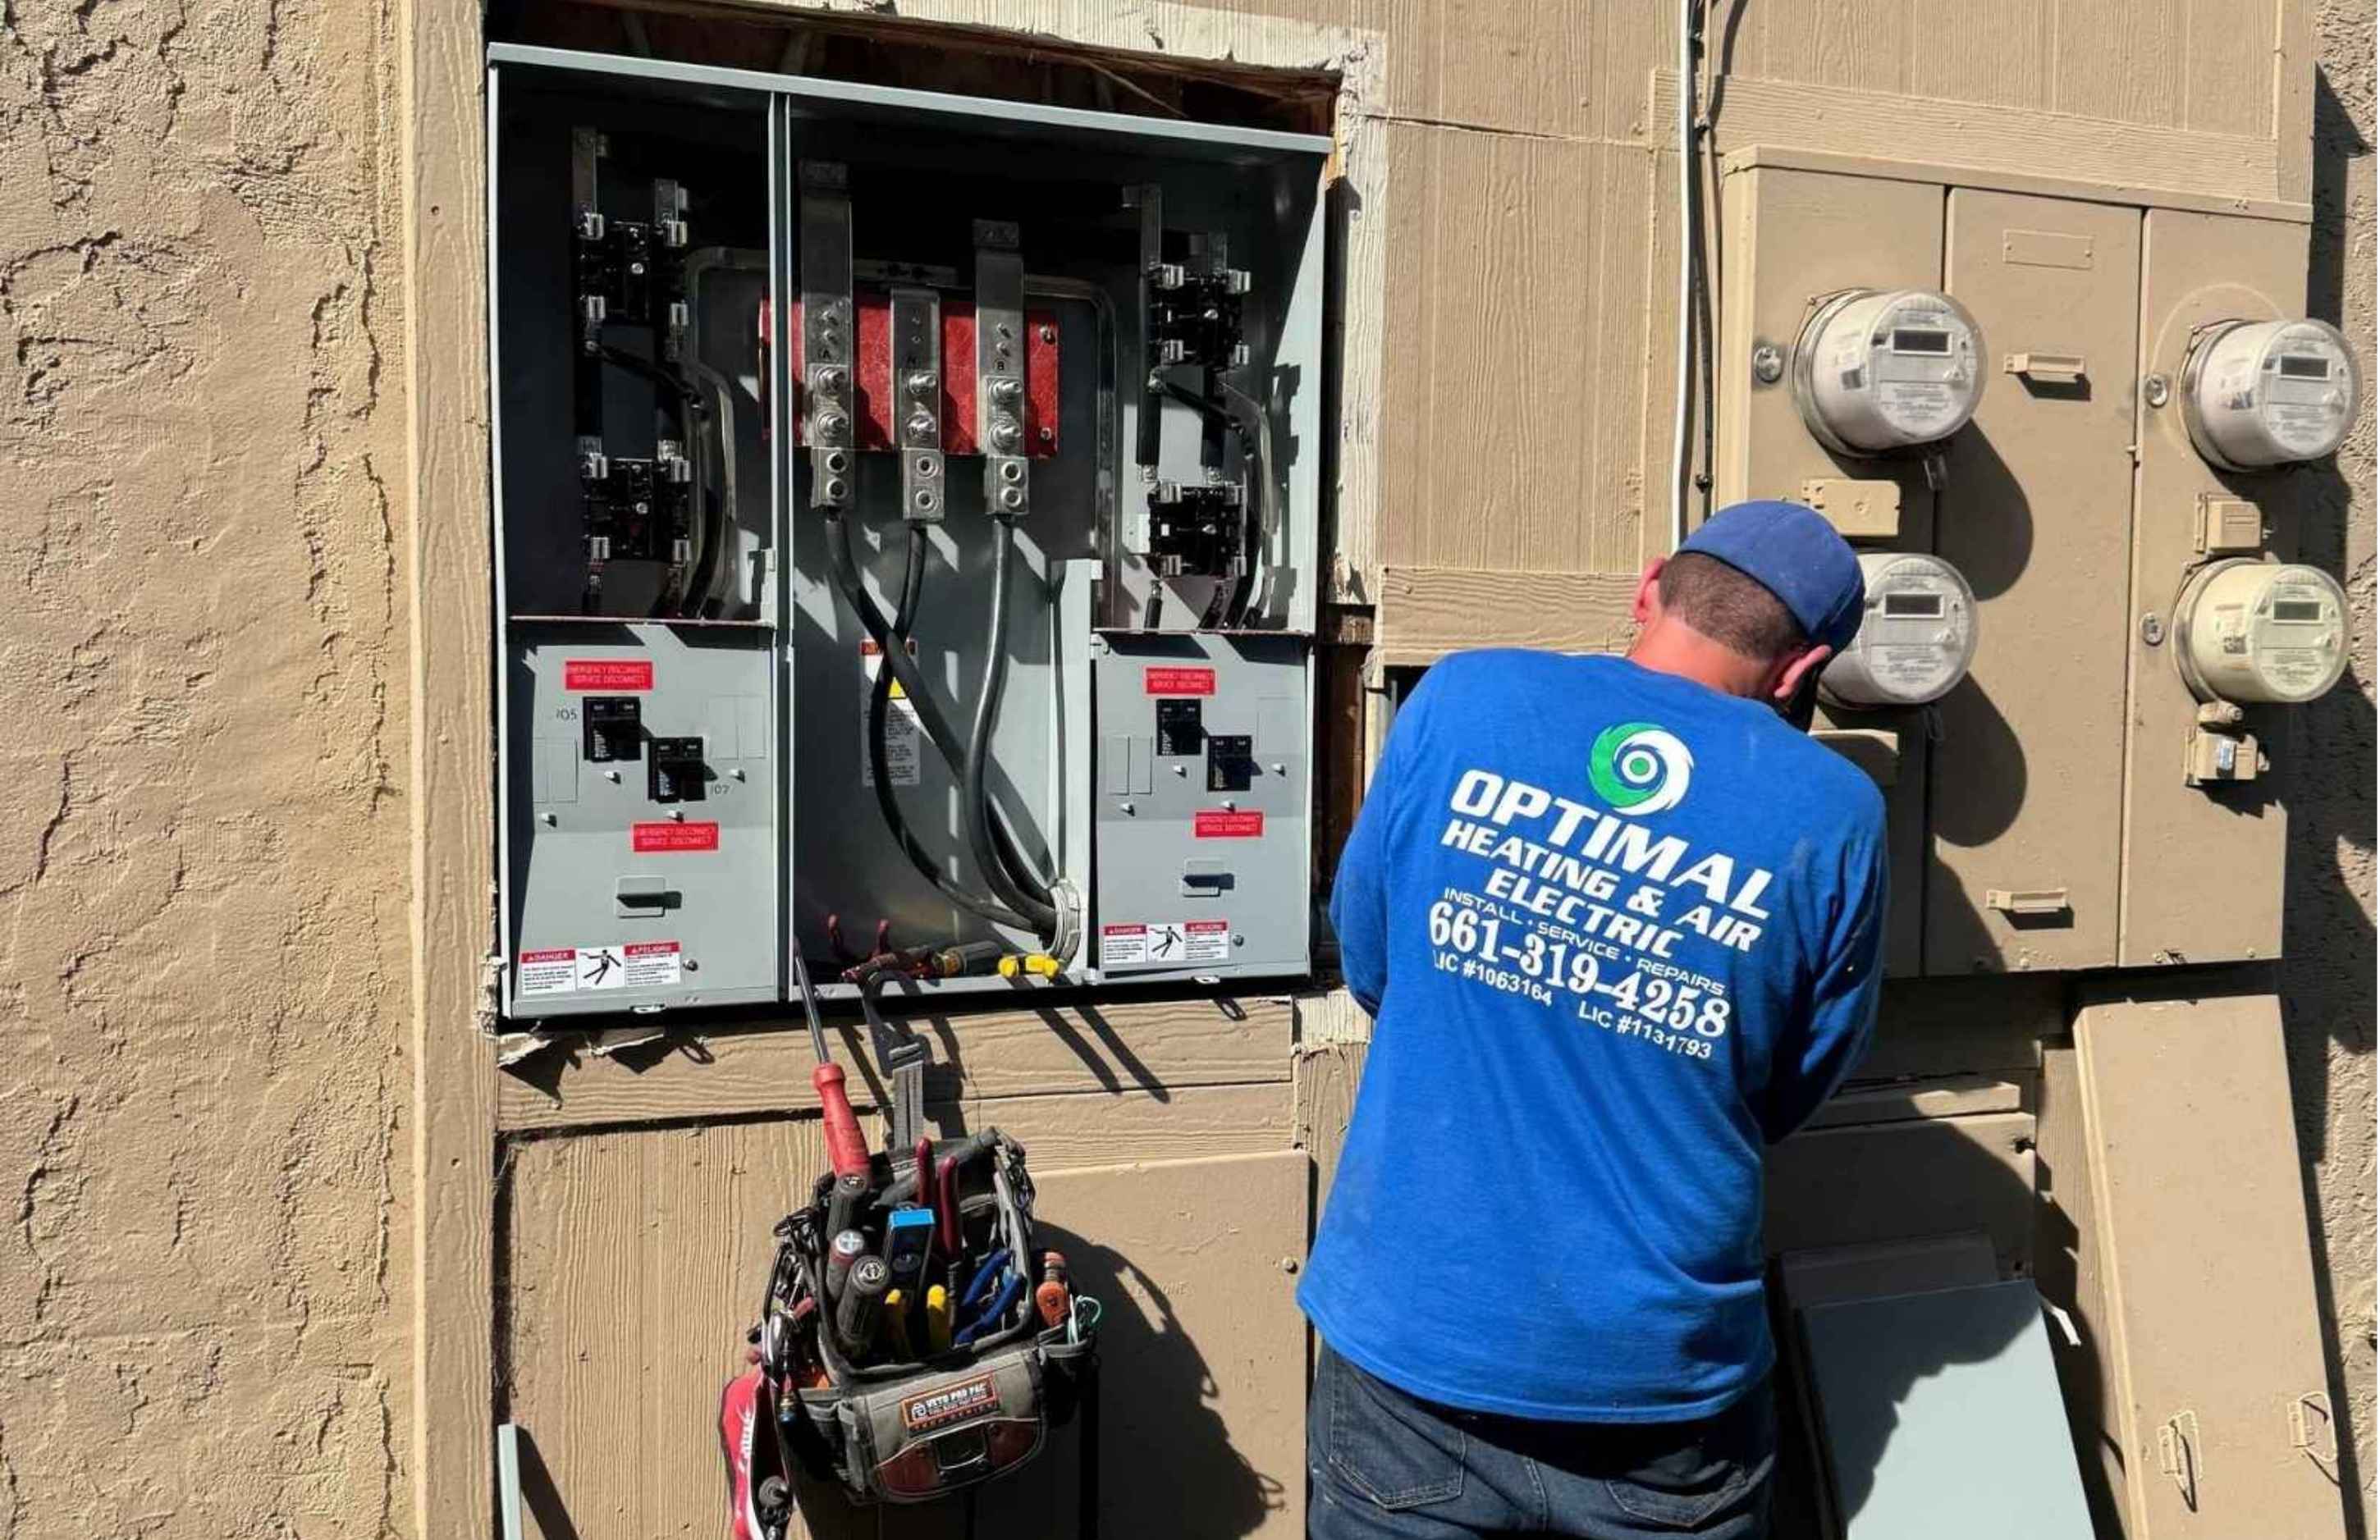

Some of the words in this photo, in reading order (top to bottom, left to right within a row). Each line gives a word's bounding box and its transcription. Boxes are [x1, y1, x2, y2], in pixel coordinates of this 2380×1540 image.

[1441, 820, 1620, 901] HEATING
[1626, 885, 1666, 916] &
[1675, 905, 1763, 952] AIR
[1449, 769, 1774, 919] OPTIMAL
[1444, 887, 1523, 925] INSTALL
[1536, 921, 1621, 961] SERVICE
[1636, 957, 1727, 996] REPAIRS
[1484, 868, 1686, 958] ELECTRIC
[1430, 901, 1731, 1038] 661-319-4258
[1432, 949, 1459, 973] LIC
[1462, 958, 1553, 1008] #1063164
[1578, 999, 1613, 1029] LIC
[1616, 1014, 1713, 1059] #1131793
